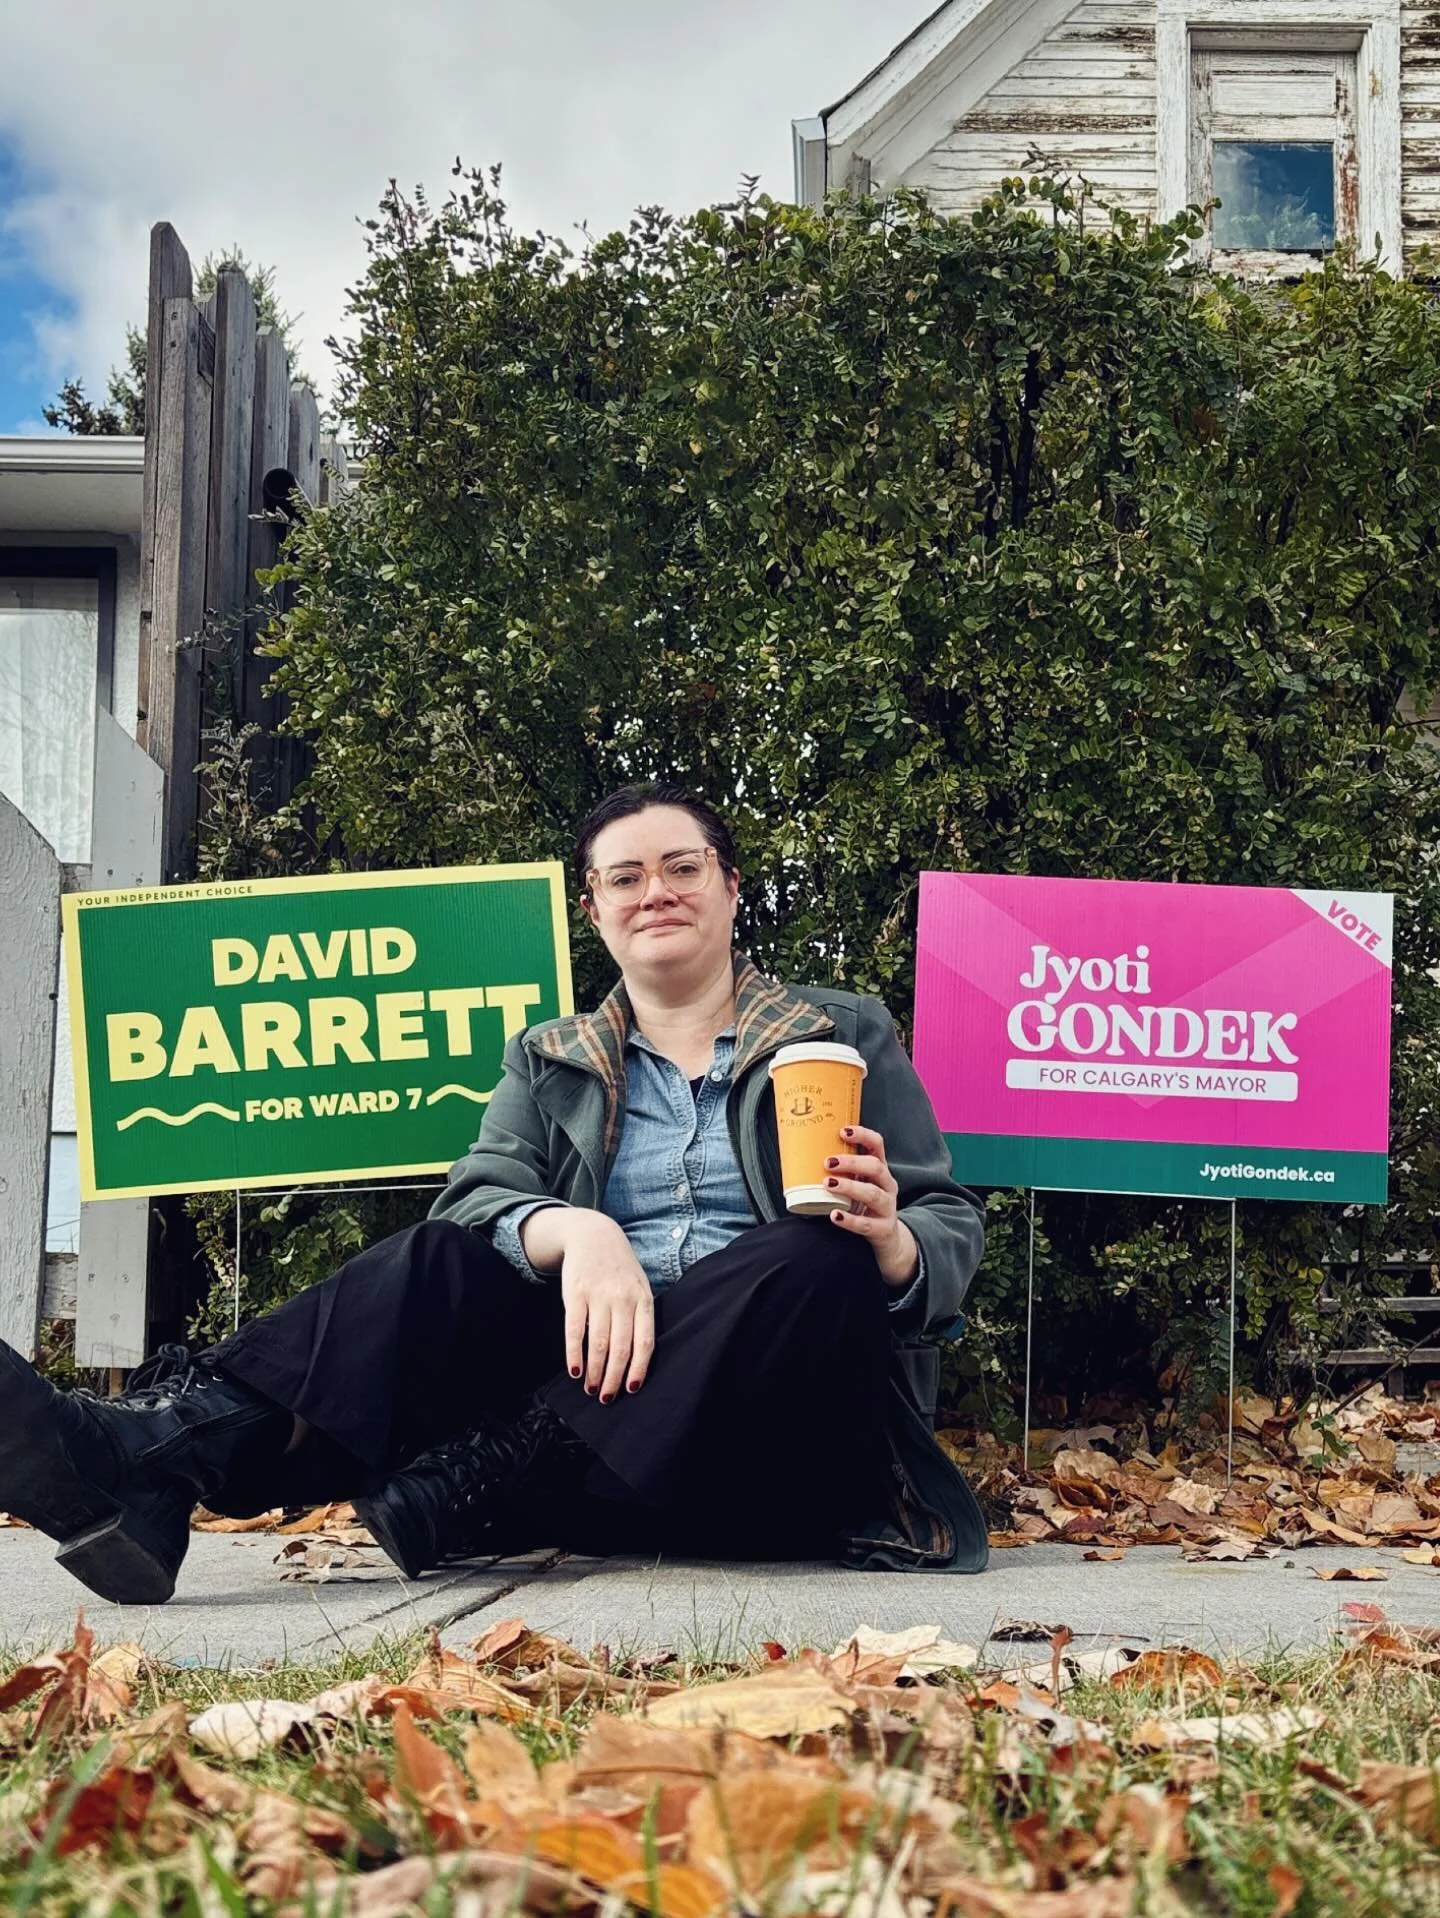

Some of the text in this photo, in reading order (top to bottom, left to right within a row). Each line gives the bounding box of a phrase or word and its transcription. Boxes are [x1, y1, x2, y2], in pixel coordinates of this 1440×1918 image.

[78, 886, 252, 906] YOUR INDEPENDENT CHOICE
[1326, 900, 1382, 952] VOTE
[212, 927, 416, 986] DAVID
[1019, 945, 1150, 1004] Jyoti
[106, 984, 541, 1082] BARRETT
[1006, 1000, 1299, 1064] GONDEK
[246, 1088, 422, 1123] FOR WARD 7
[1039, 1067, 1267, 1093] FOR CALGARY'S MAYOR
[1199, 1162, 1335, 1184] JyotiGondek.ca
